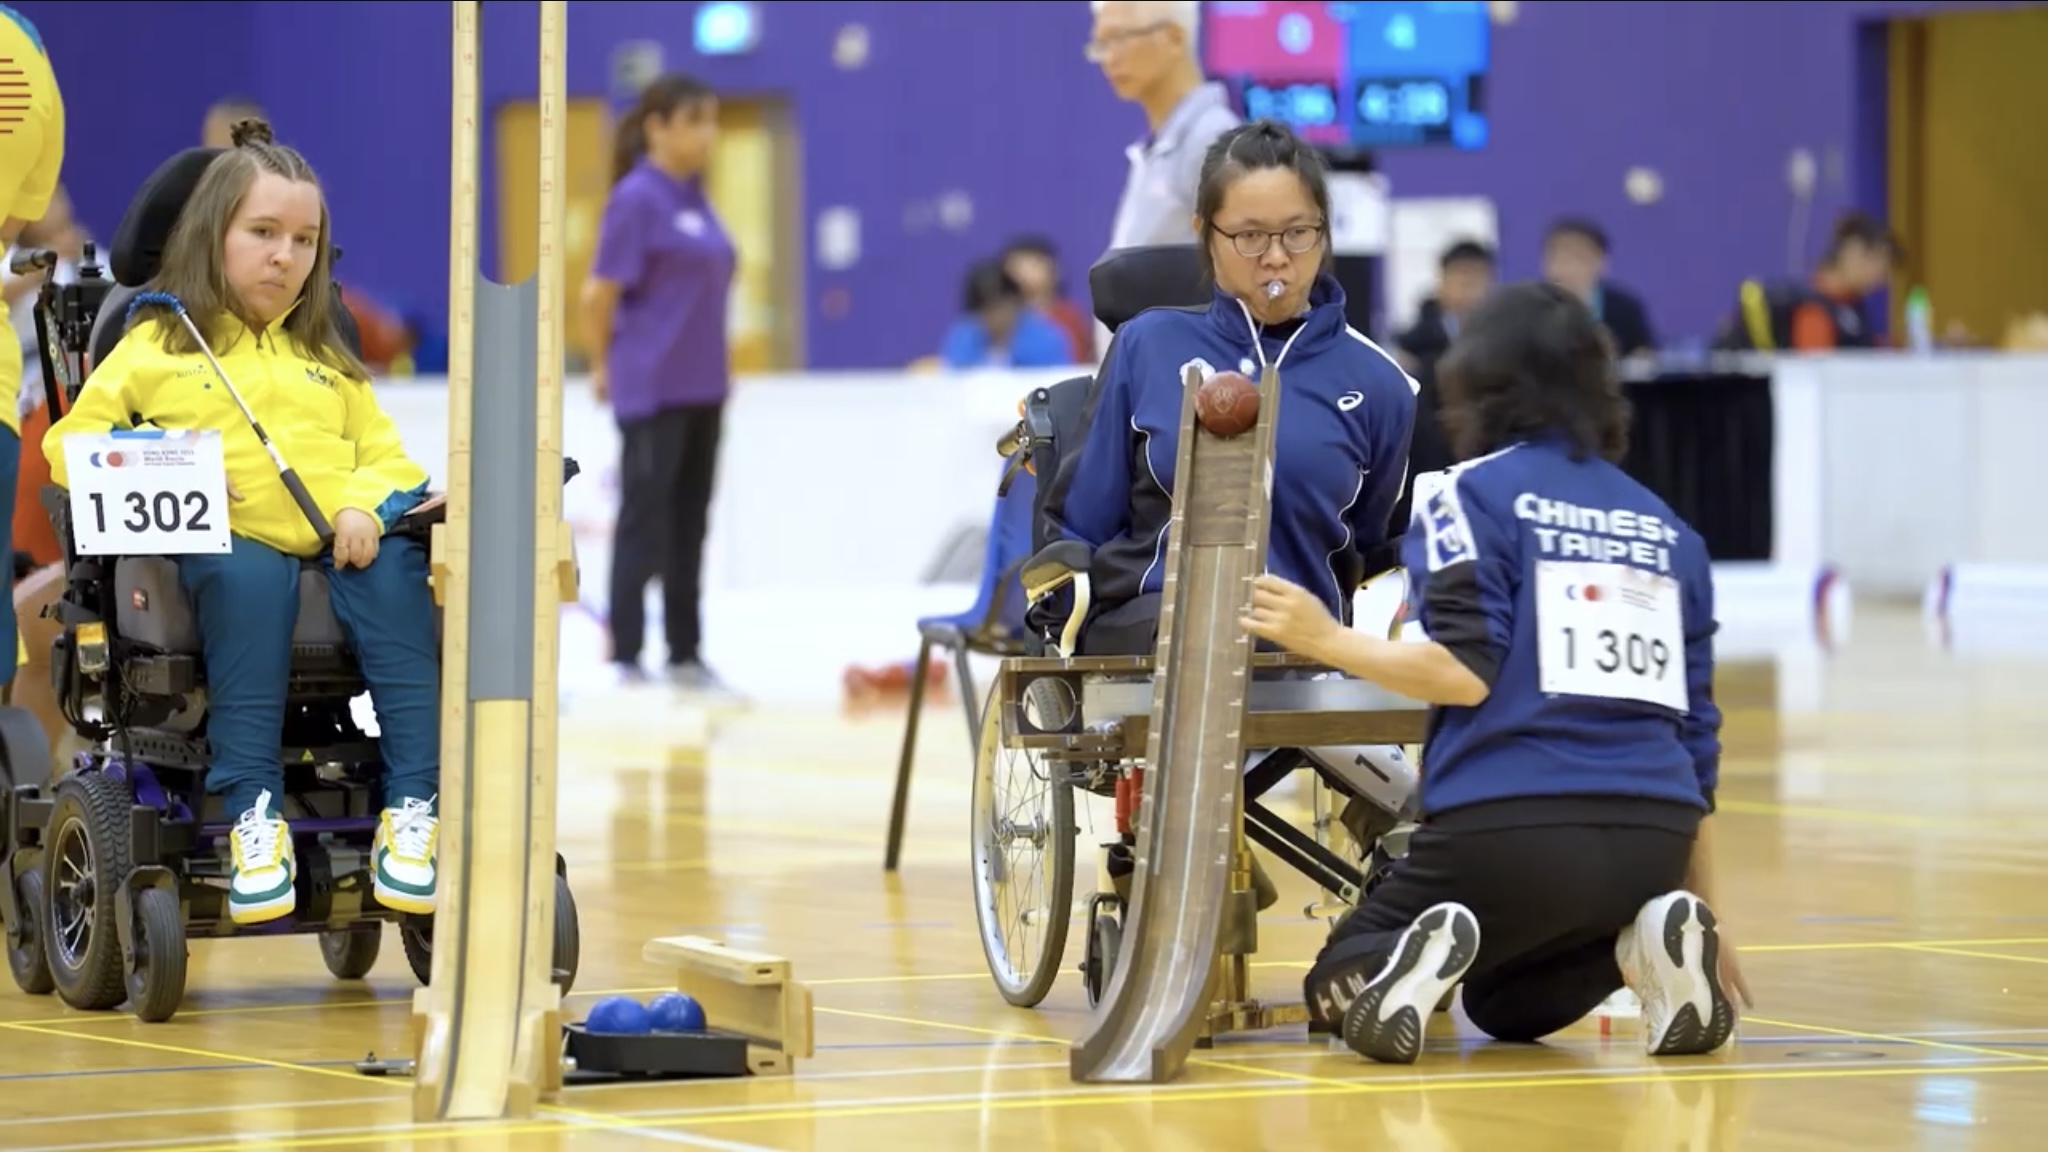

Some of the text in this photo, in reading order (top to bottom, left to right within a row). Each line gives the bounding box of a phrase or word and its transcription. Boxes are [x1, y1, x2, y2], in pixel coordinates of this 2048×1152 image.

[123, 490, 211, 533] 302
[1533, 527, 1671, 572] TAIPEI
[1595, 629, 1669, 681] 309
